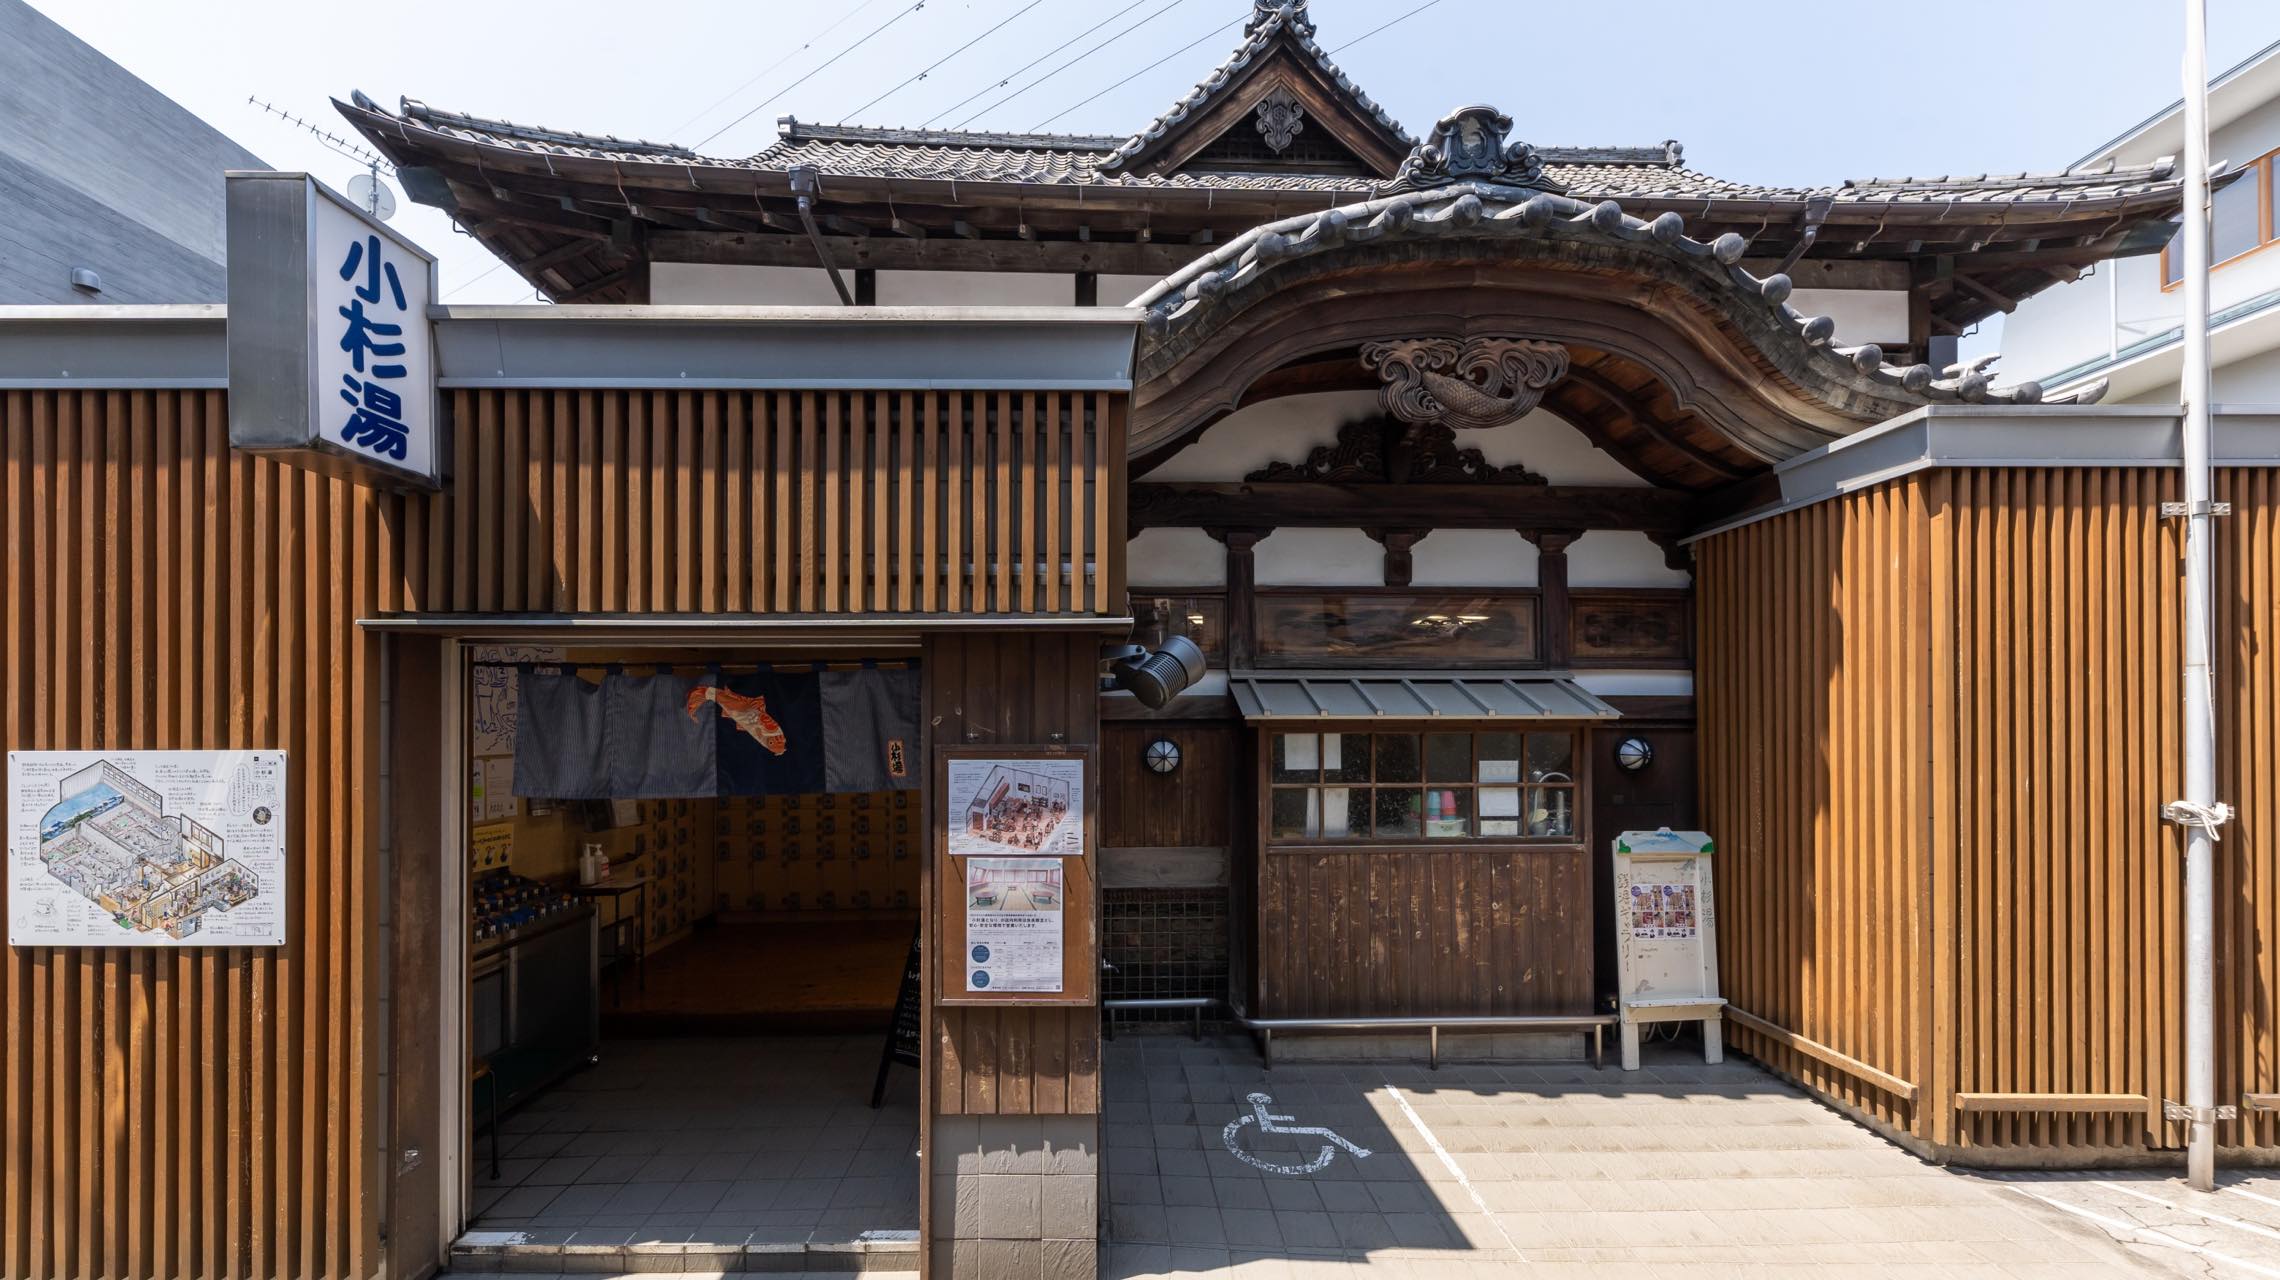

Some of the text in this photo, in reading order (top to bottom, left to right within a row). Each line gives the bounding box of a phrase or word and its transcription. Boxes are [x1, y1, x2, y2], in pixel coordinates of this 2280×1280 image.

[339, 235, 409, 460] 小杉湯
[890, 742, 904, 774] 小杉湯
[1700, 871, 1714, 928] 小杉湯
